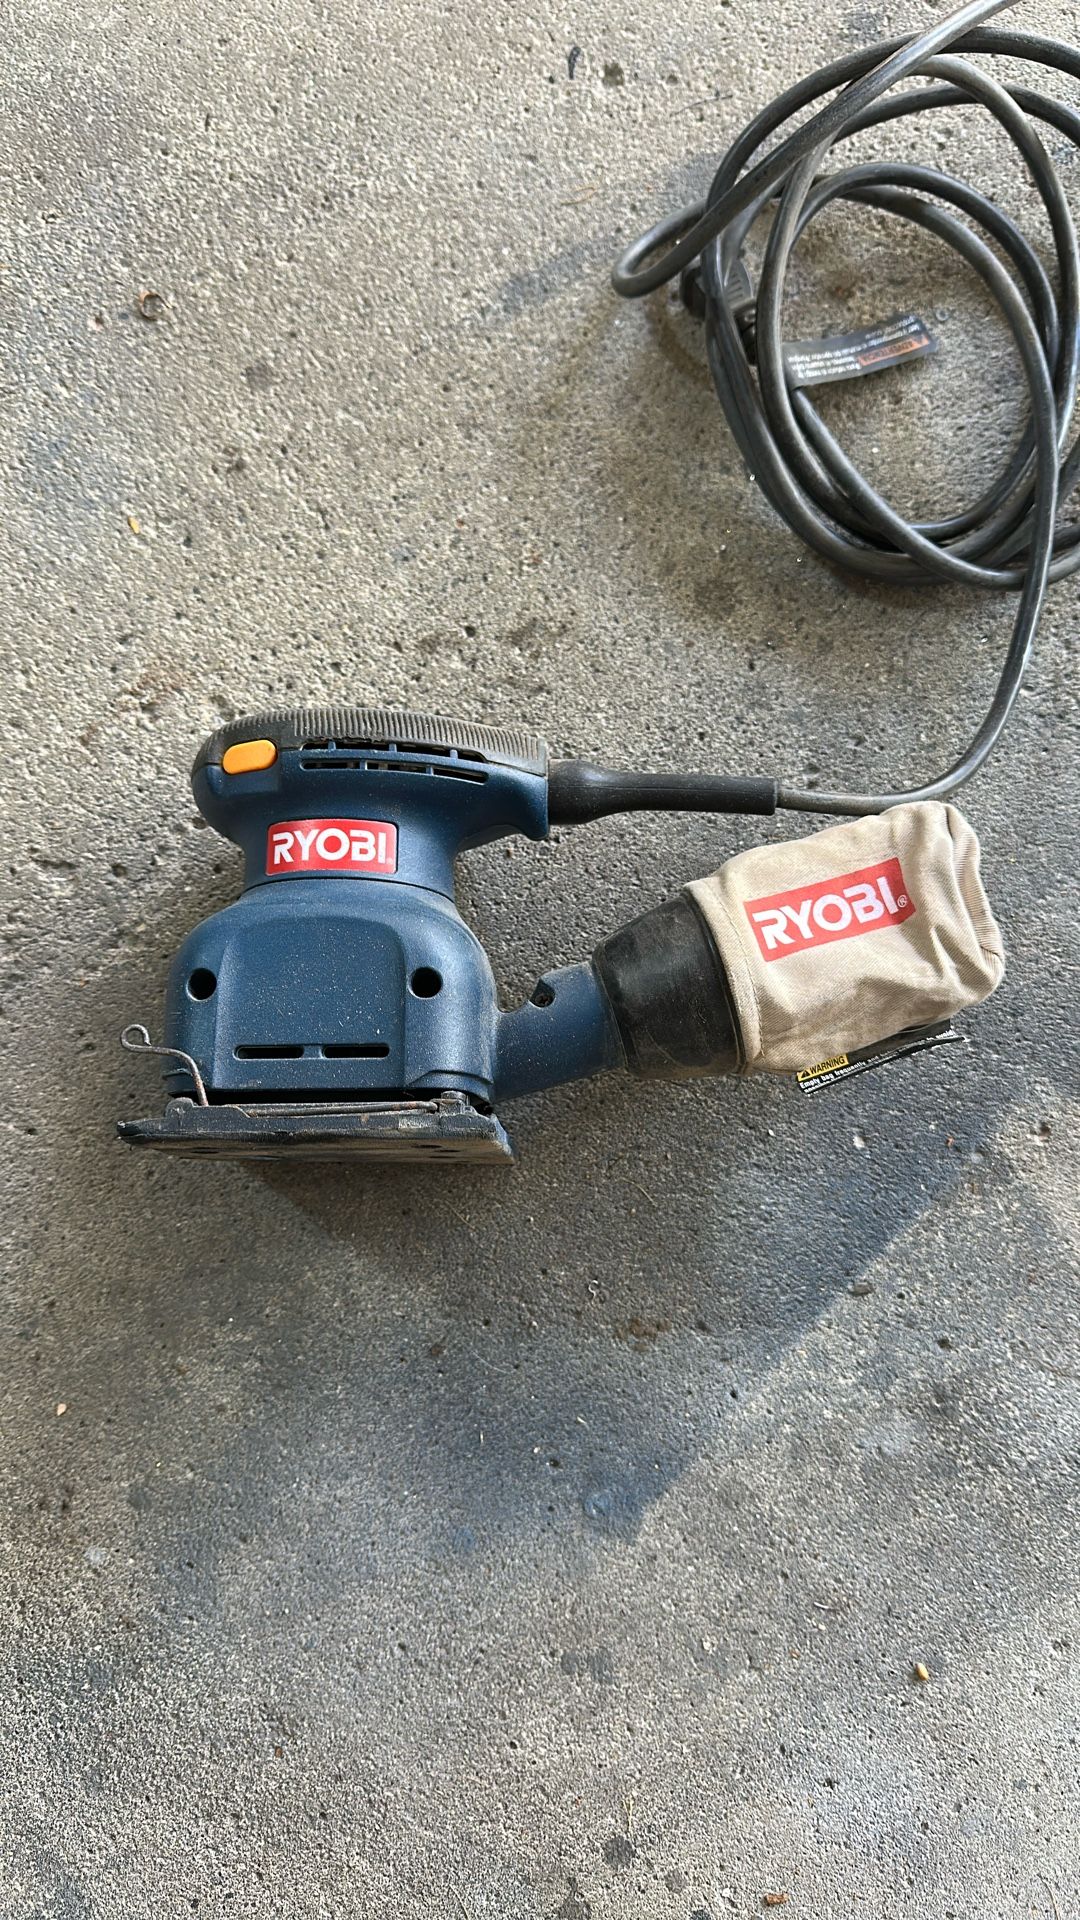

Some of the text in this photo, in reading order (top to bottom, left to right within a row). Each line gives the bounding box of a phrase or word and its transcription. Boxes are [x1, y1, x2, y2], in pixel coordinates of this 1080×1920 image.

[272, 827, 387, 865] RYOBI
[752, 876, 899, 950] RYOBI
[799, 1076, 821, 1090] Empty
[821, 1072, 835, 1083] bag
[834, 1059, 867, 1078] frequently
[809, 1055, 846, 1075] WARNING
